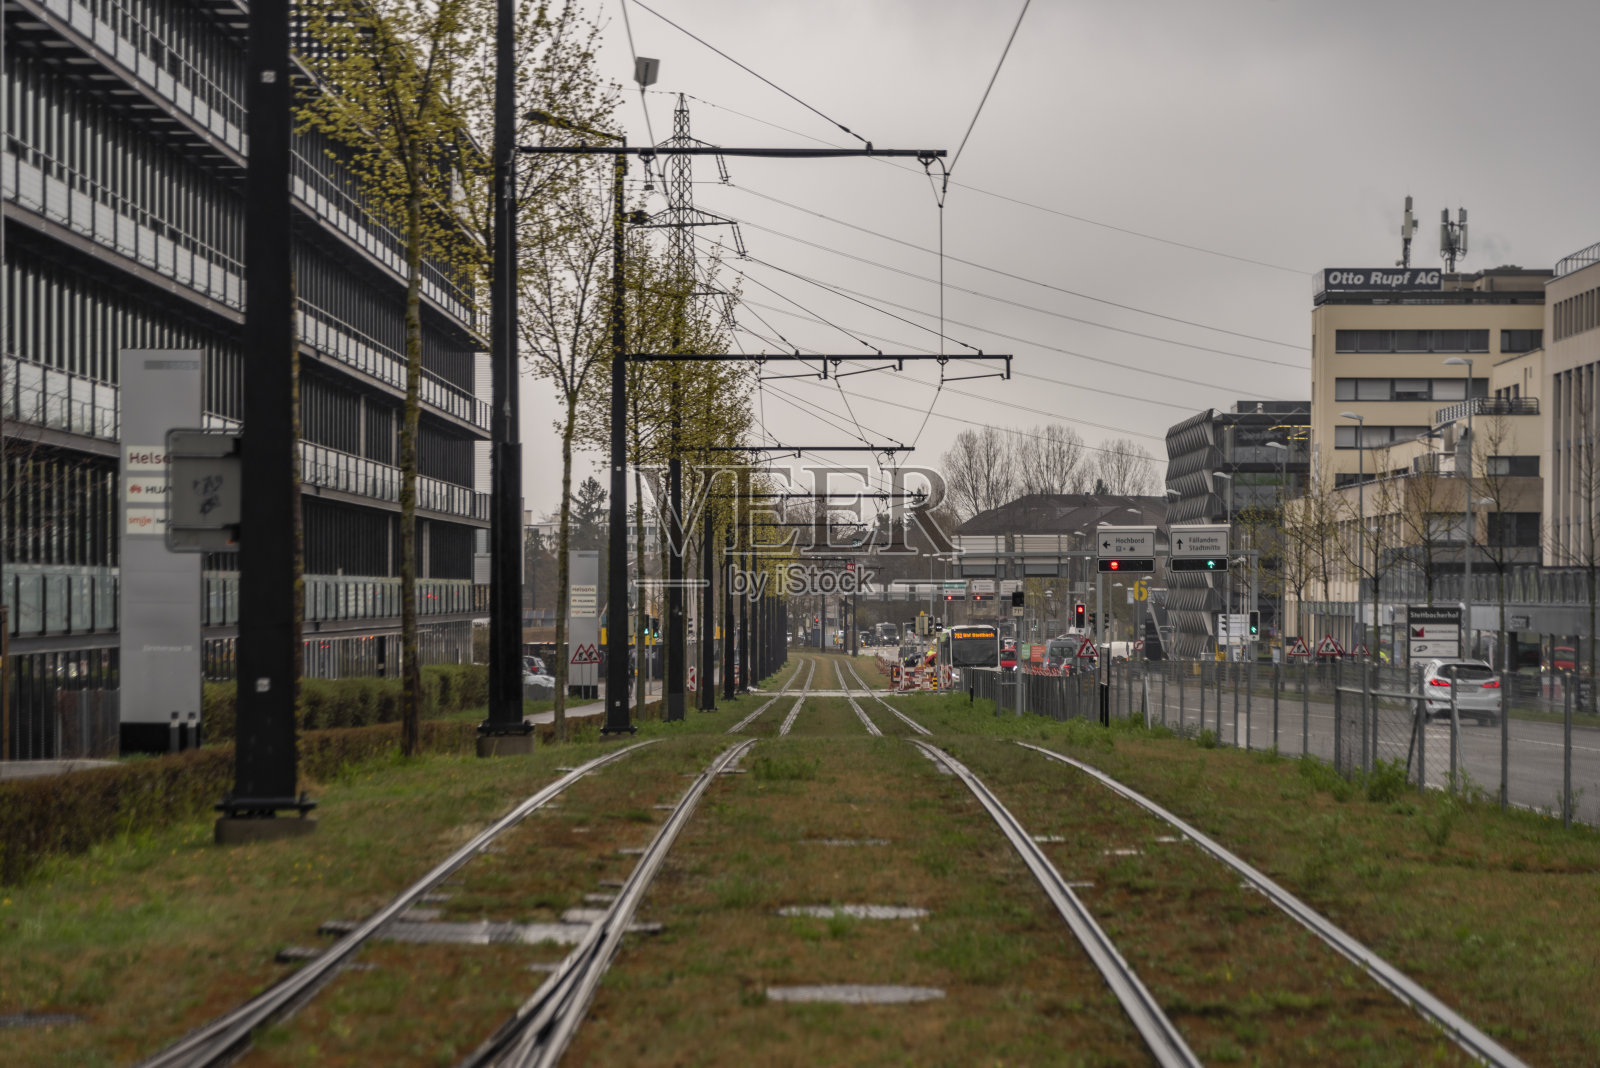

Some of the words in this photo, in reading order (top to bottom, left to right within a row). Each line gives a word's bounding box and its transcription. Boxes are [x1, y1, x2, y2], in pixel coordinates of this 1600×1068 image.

[1328, 271, 1364, 285] Otto
[1369, 271, 1411, 287] Rupf
[1414, 271, 1440, 285] AG
[129, 452, 172, 464] Helsa
[1133, 581, 1148, 602] 6
